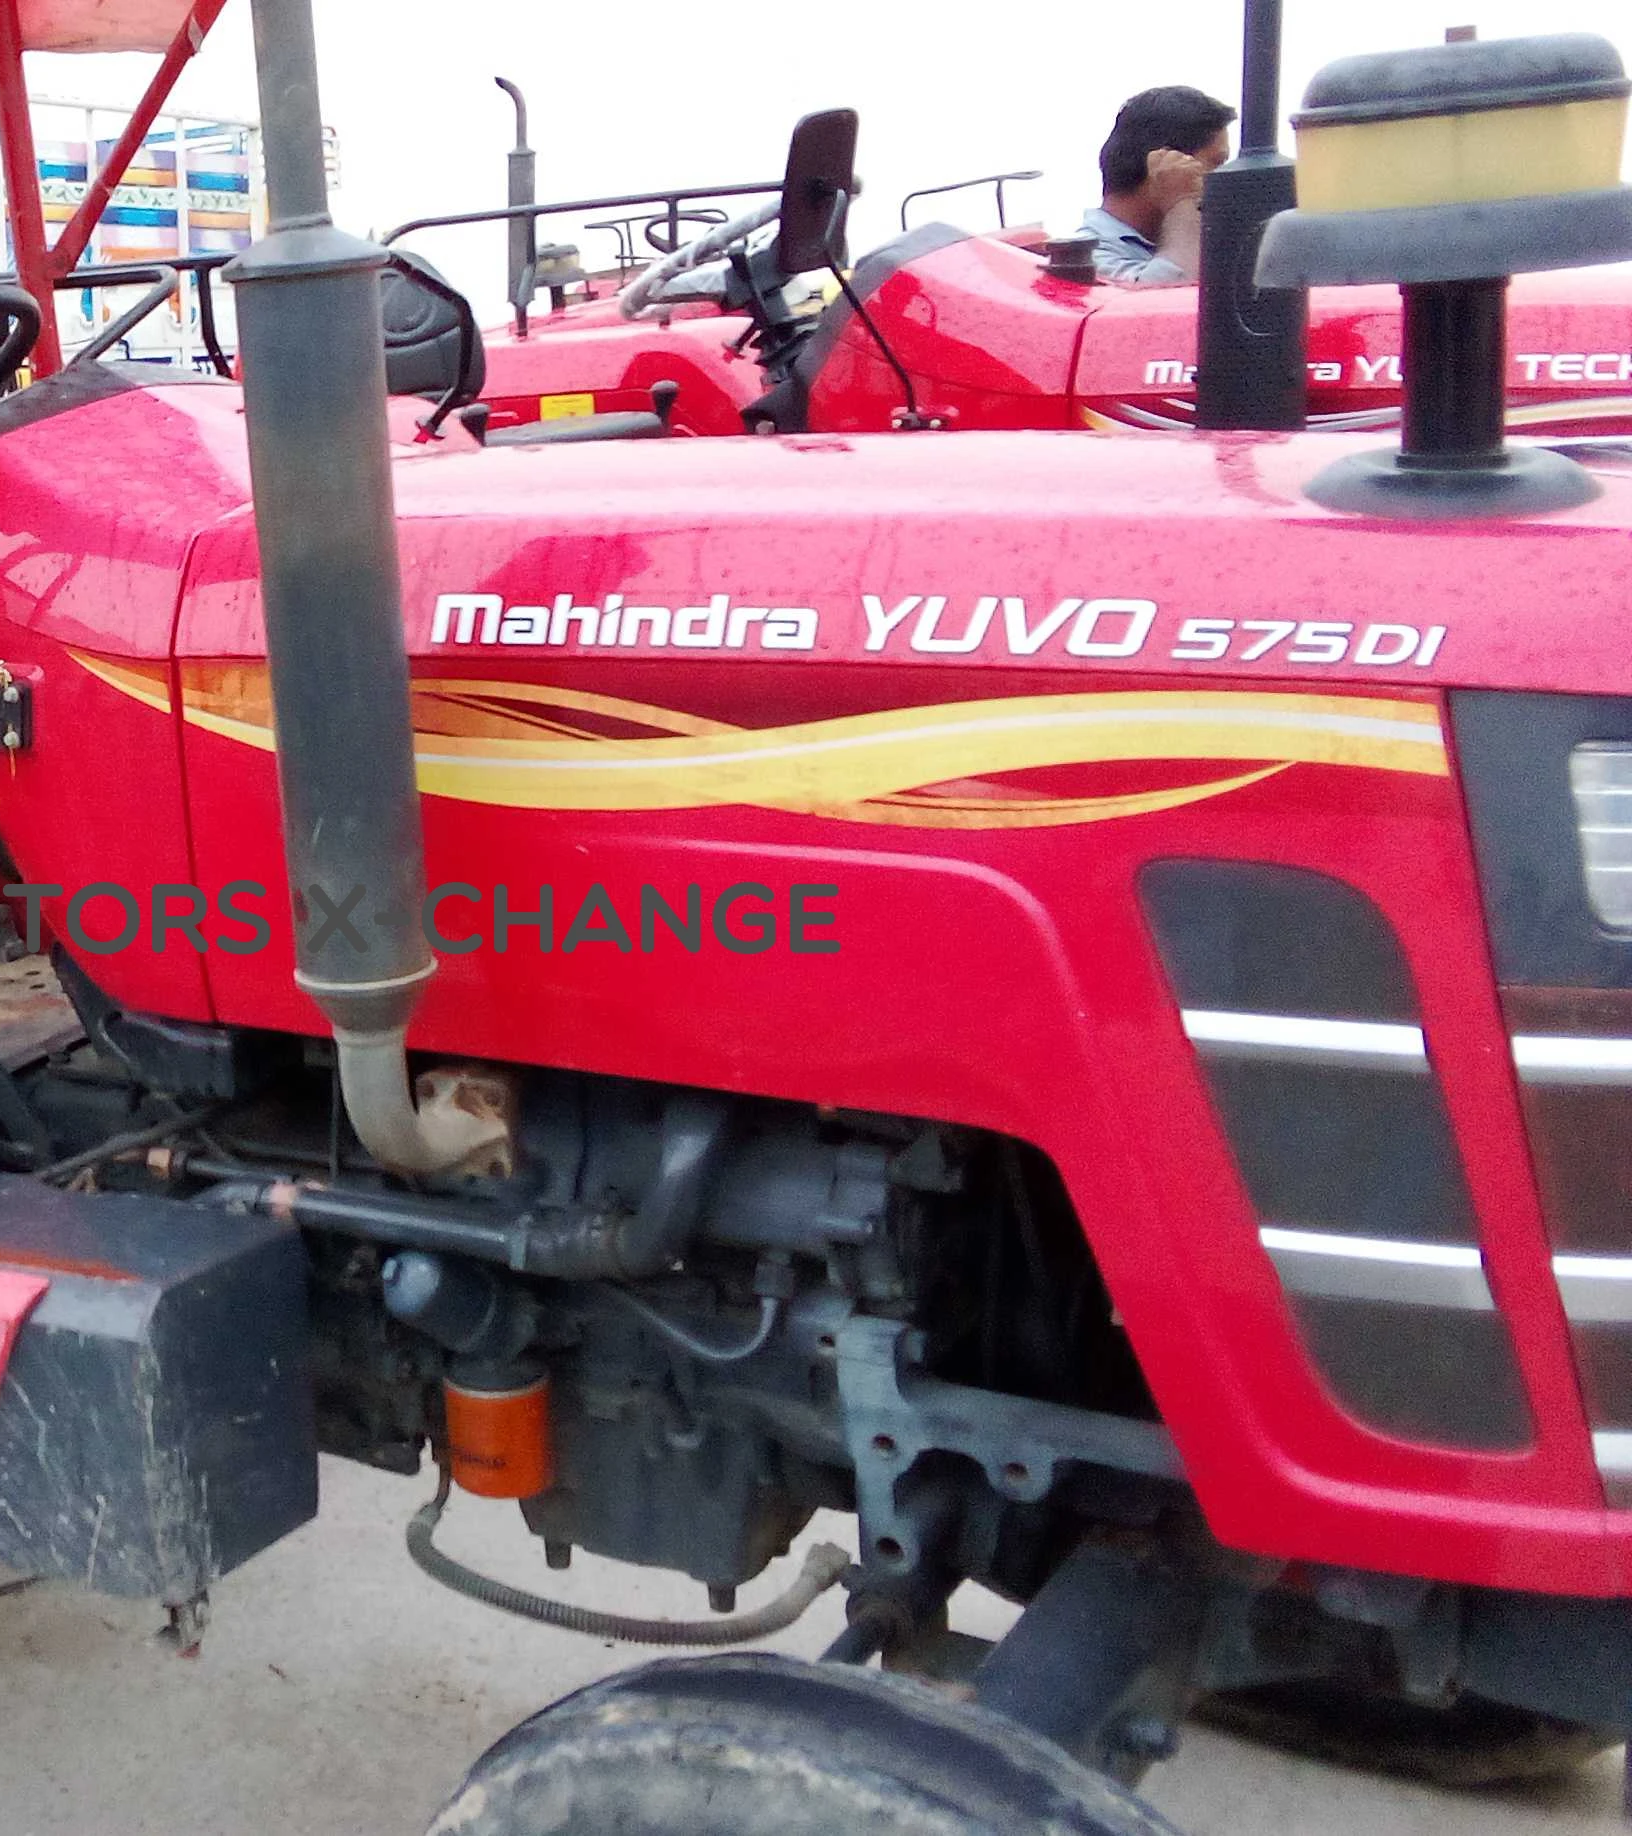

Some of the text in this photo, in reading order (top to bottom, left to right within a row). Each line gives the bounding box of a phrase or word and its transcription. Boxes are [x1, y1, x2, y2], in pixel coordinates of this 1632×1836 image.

[430, 591, 1448, 667] Mahindra YUVO 575DI
